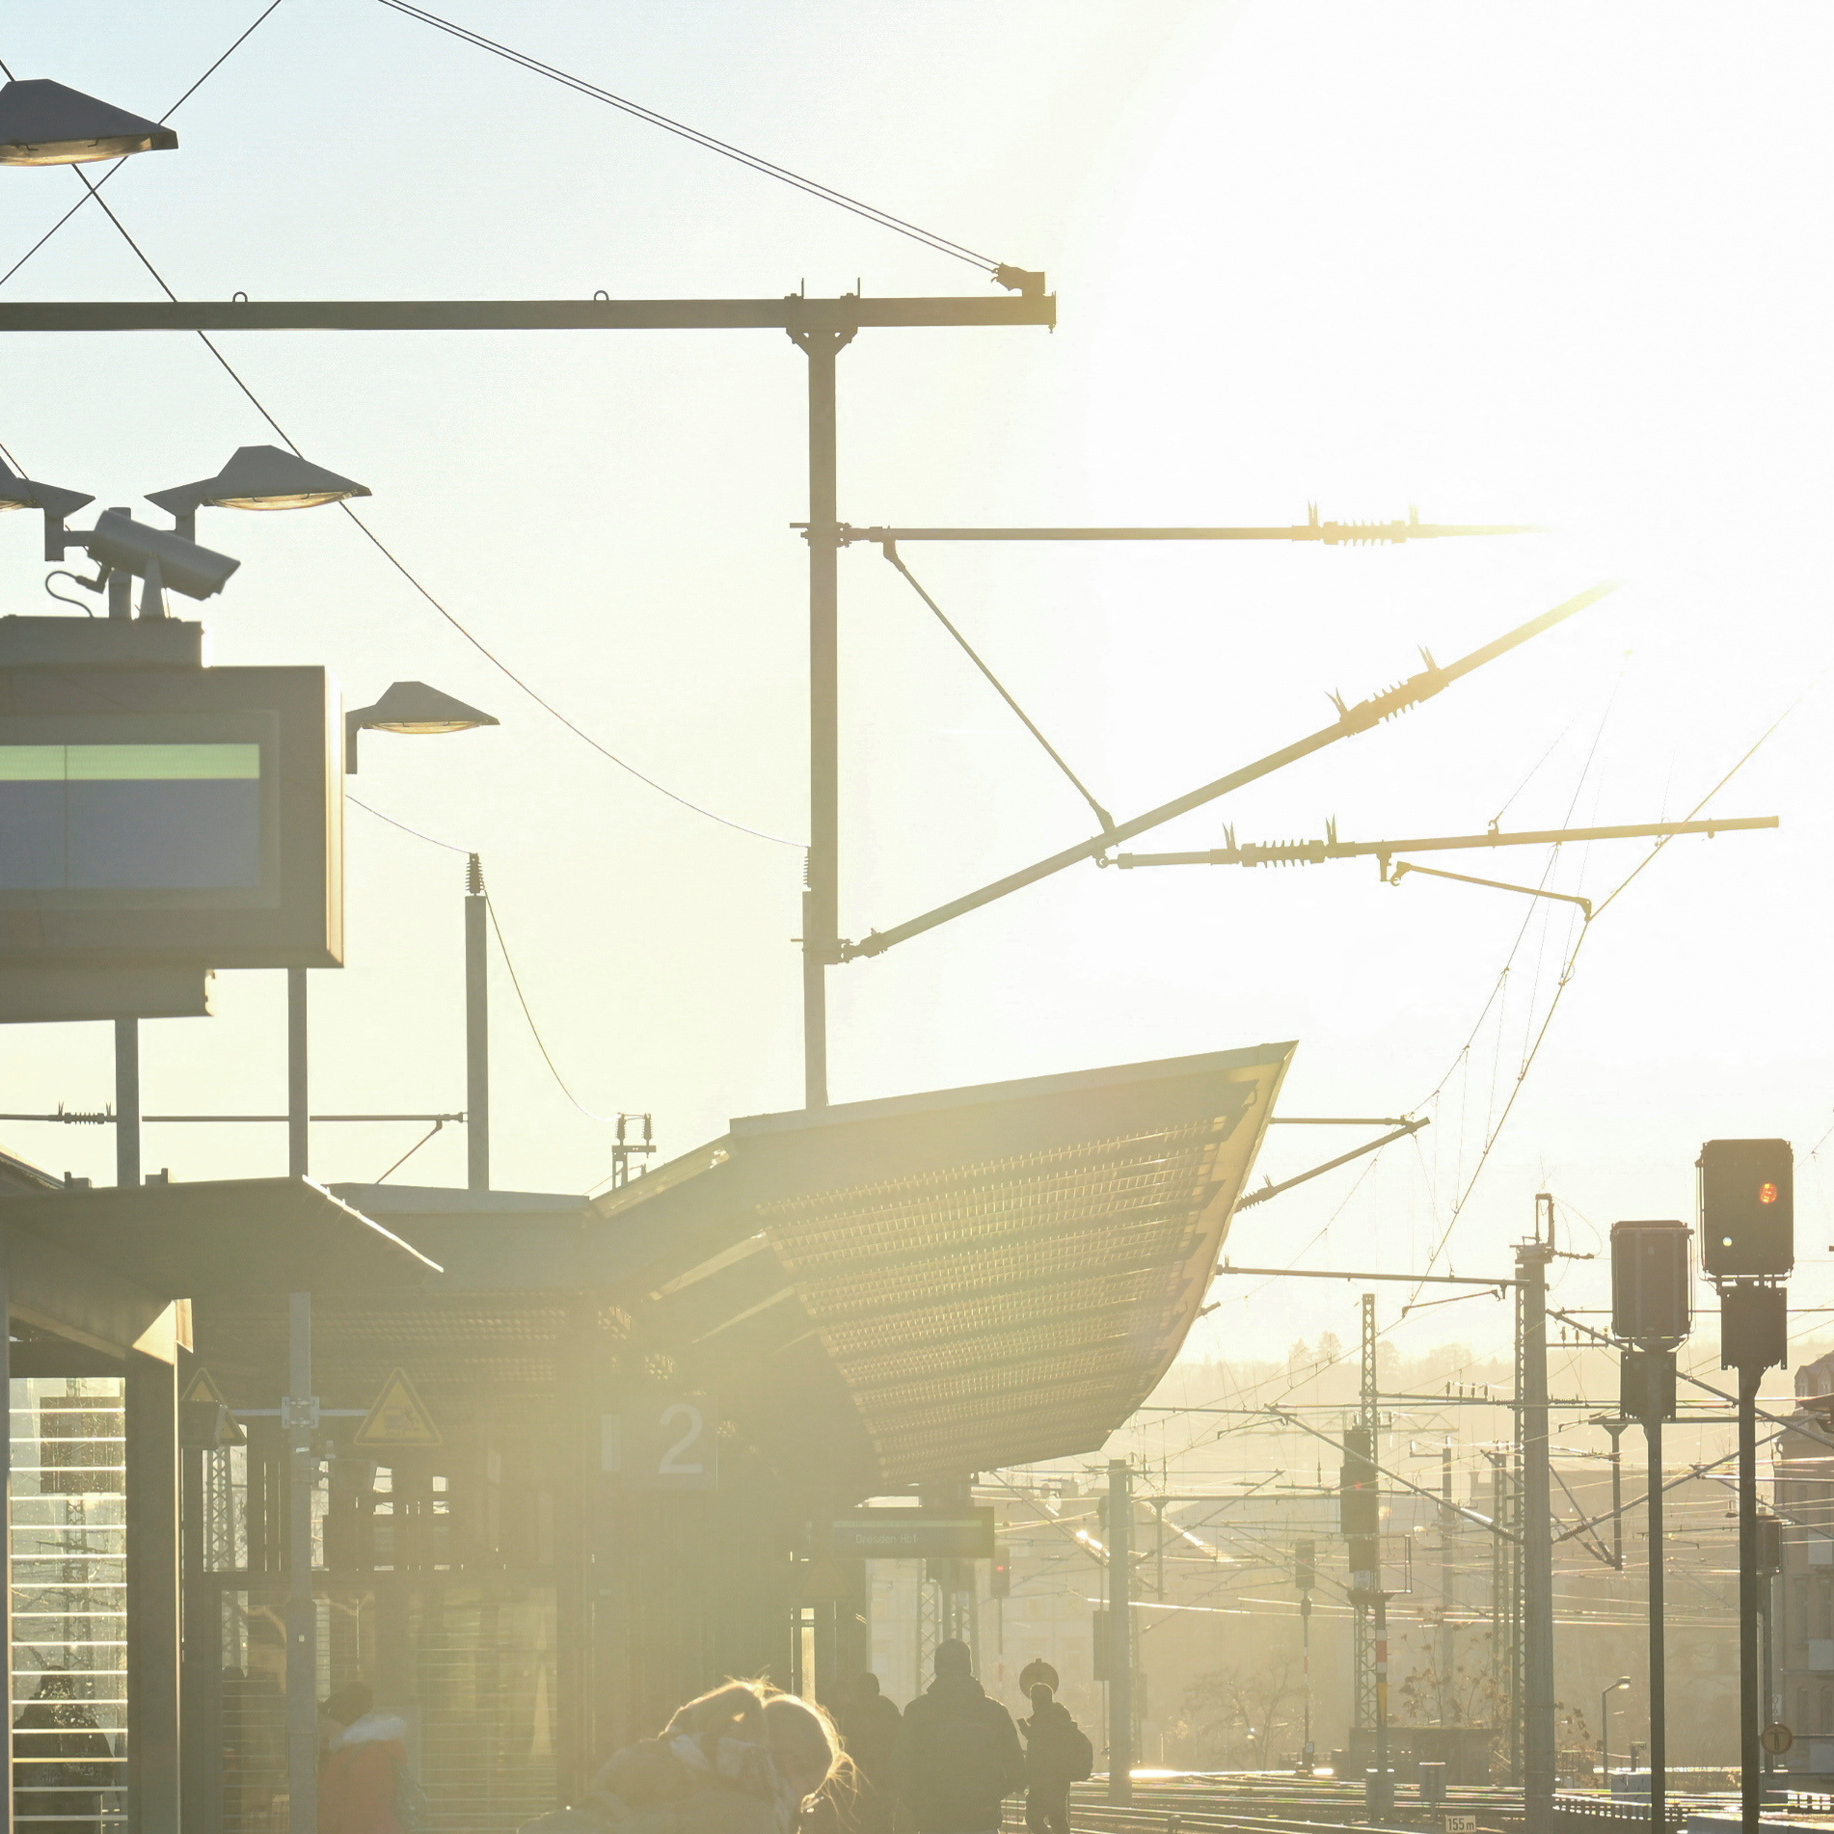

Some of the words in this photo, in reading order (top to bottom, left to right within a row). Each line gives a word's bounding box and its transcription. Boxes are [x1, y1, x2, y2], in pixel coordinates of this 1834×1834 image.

[657, 1403, 704, 1475] 2
[855, 1533, 897, 1544] Dresden
[1448, 1817, 1464, 1831] 155
[1466, 1822, 1474, 1831] m
